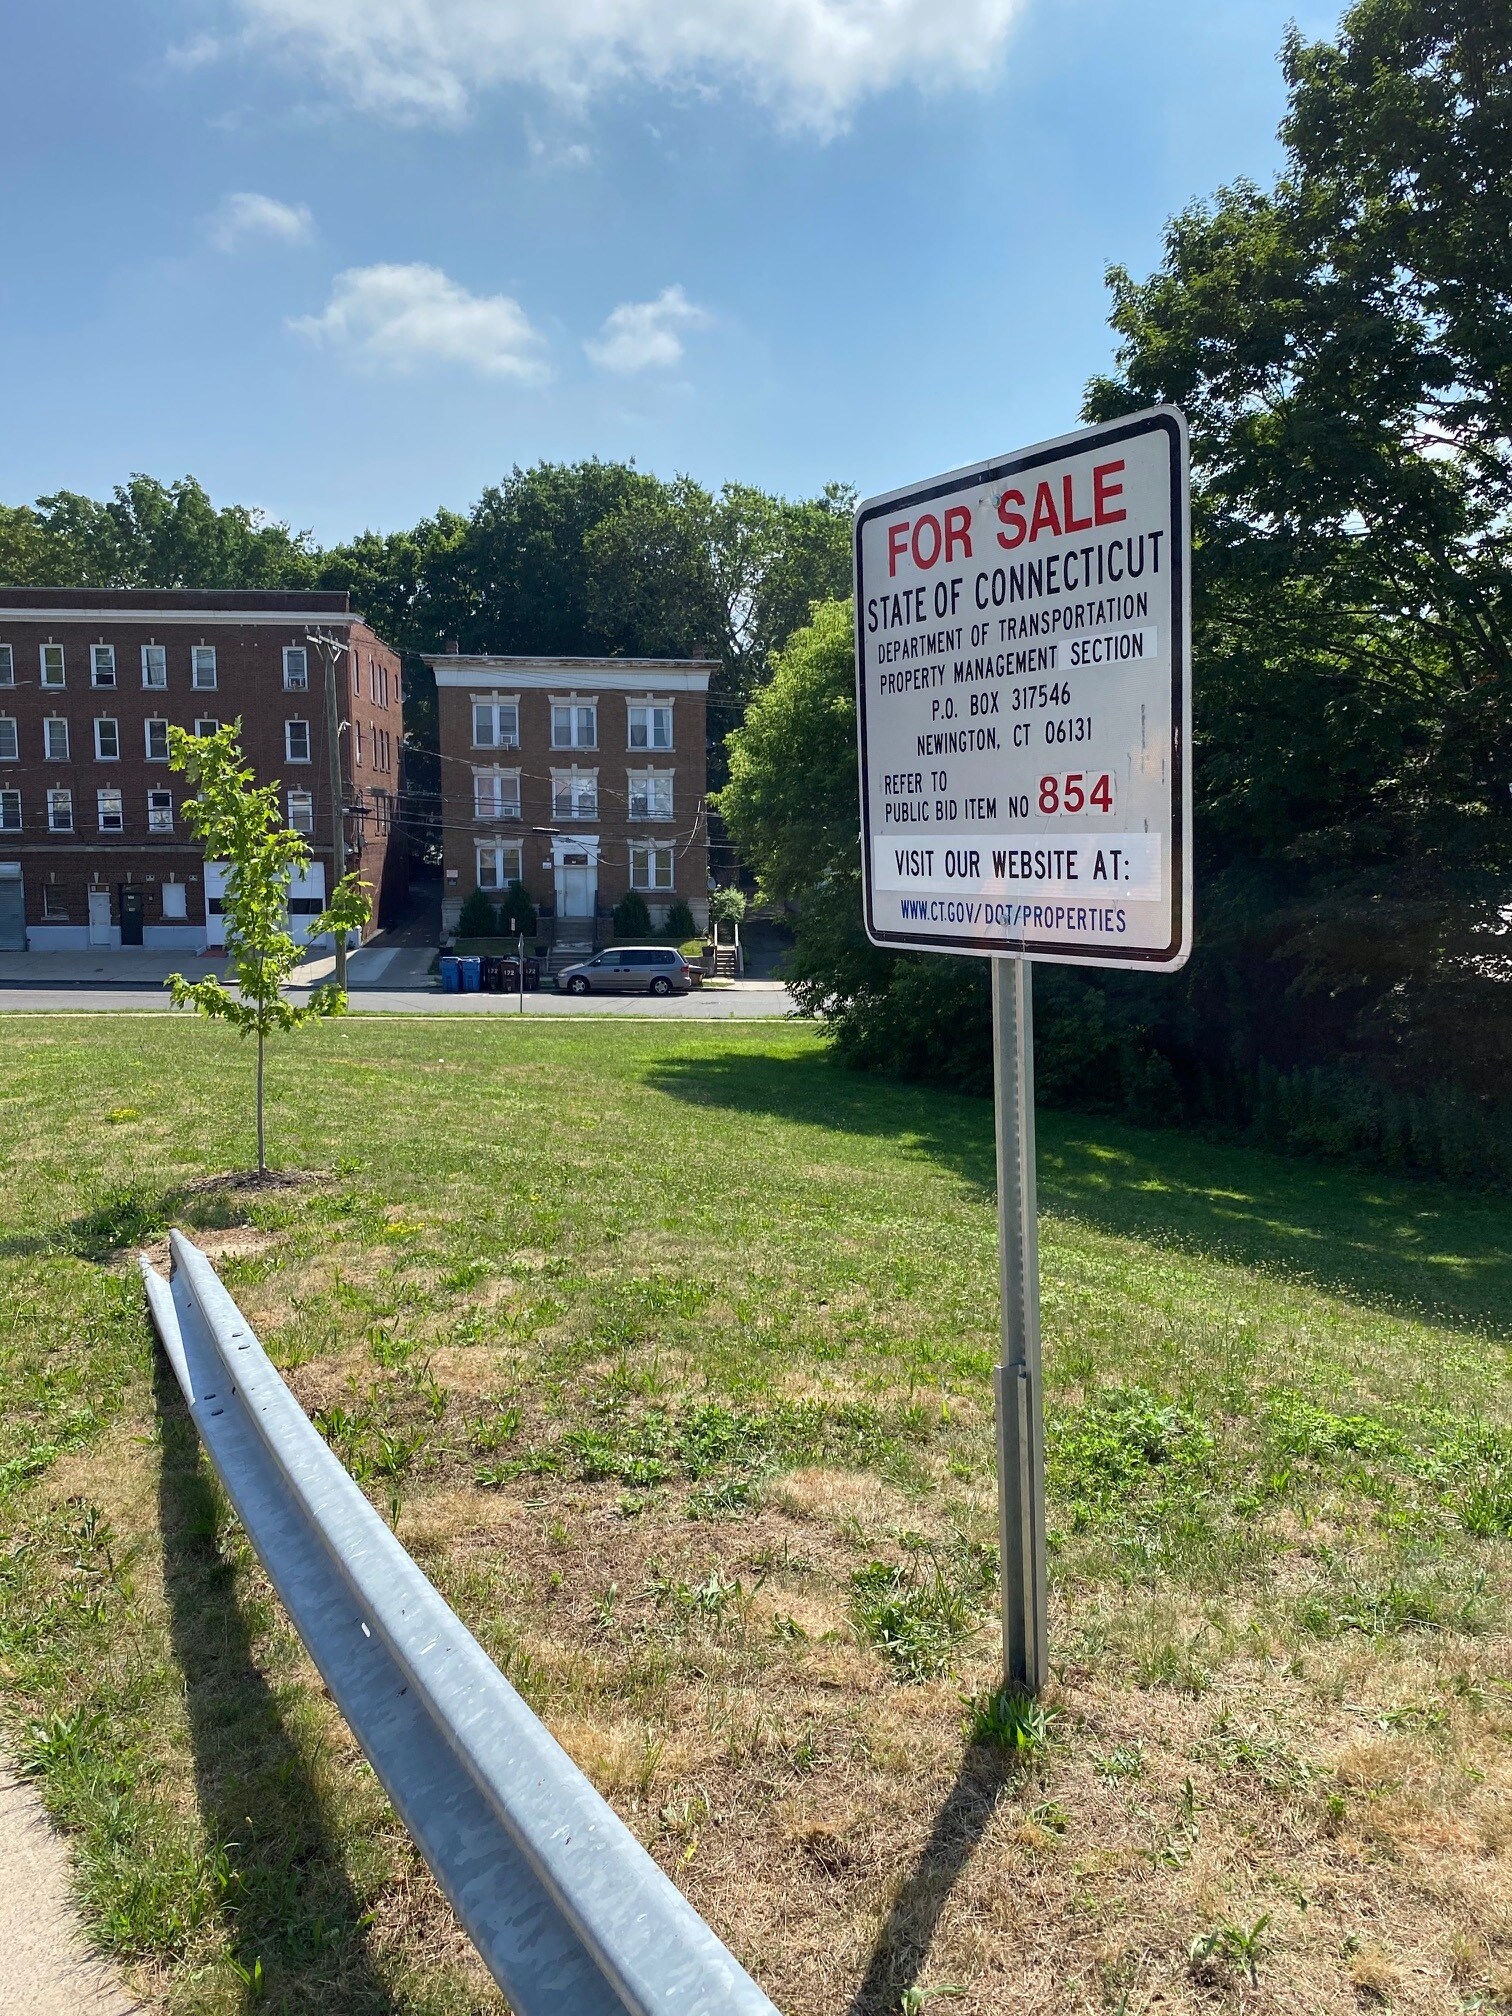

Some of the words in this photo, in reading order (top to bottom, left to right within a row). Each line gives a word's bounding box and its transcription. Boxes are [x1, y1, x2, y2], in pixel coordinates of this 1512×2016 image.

[888, 505, 973, 577] FOR
[997, 459, 1127, 549] SALE
[868, 586, 927, 633] STATE
[935, 578, 963, 618] OF
[975, 530, 1164, 609] CONNECTICUT
[878, 628, 963, 664] DEPARTMENT
[971, 622, 990, 646] OF
[999, 591, 1148, 642] TRANSPORTATION
[880, 664, 945, 695] PROPERTY
[953, 646, 1058, 683] MANAGEMENT
[1070, 633, 1143, 665] SECTION
[932, 700, 958, 721] P.O.
[970, 691, 999, 716] BOX
[1012, 681, 1071, 711] 317546
[917, 727, 1000, 757] NEWINGTON,
[1013, 723, 1031, 747] CT
[1045, 717, 1092, 744] 06131
[884, 774, 923, 795] REFER
[931, 771, 948, 792] TO
[885, 801, 930, 823] PUBLIC
[935, 800, 958, 821] BID
[965, 798, 997, 820] ITEM
[1008, 795, 1029, 818] NO
[1038, 774, 1113, 814] 854
[895, 850, 934, 877] VISIT
[944, 850, 981, 878] OUR
[992, 850, 1079, 880] WEBSITE
[1093, 850, 1131, 881] AT:
[900, 899, 1127, 933] WWW.CT.GOV/DOT/PROPERTIES
